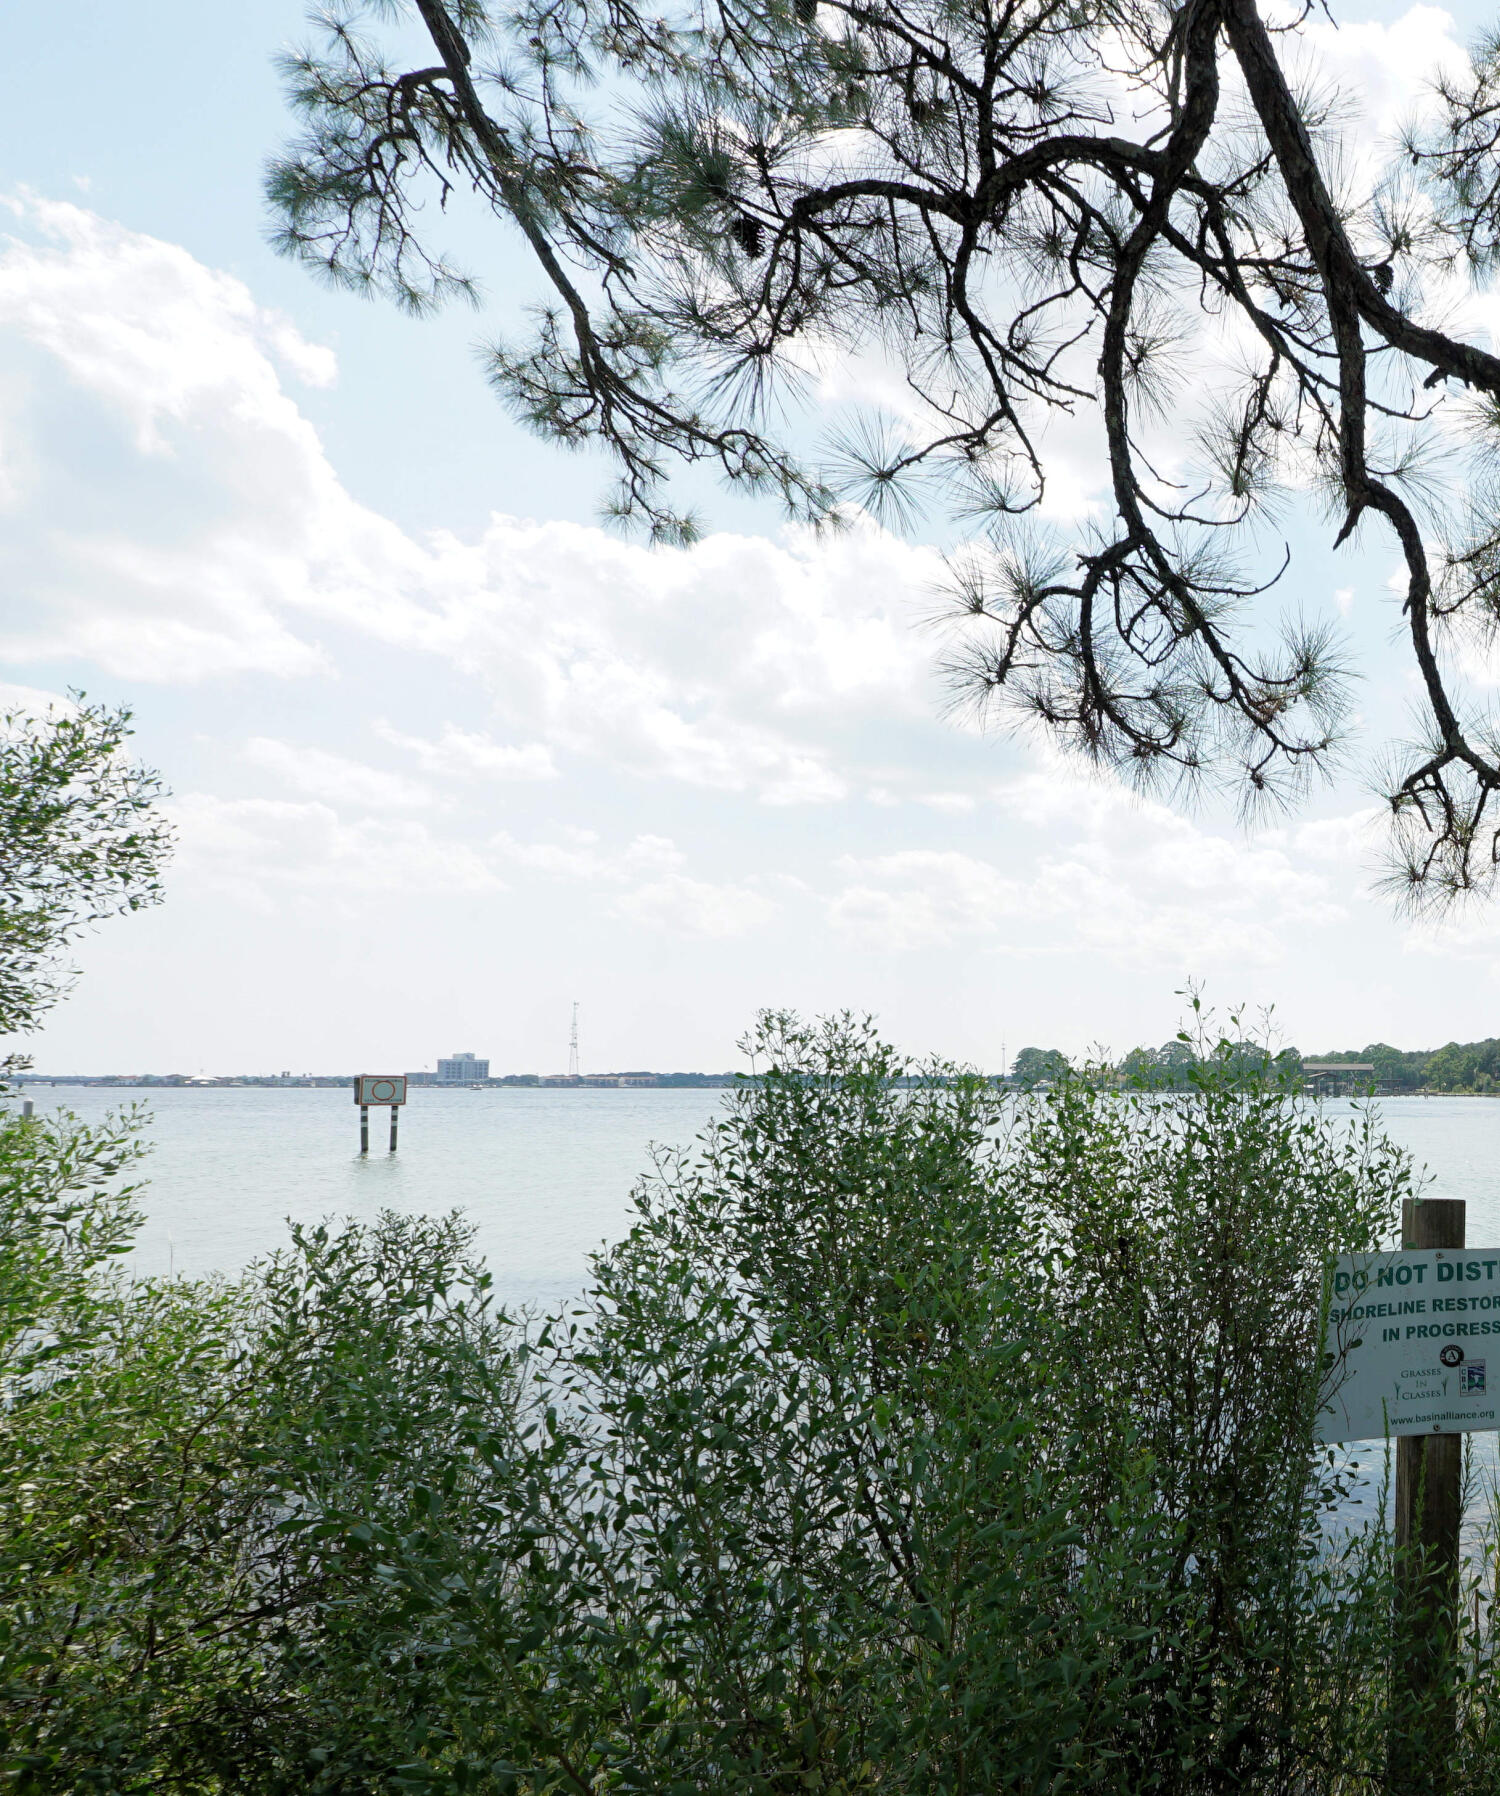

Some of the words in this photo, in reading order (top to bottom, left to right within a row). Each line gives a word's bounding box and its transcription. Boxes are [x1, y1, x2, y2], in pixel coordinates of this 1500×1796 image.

[1335, 1270, 1368, 1292] DO
[1377, 1263, 1428, 1287] NOT
[1330, 1299, 1426, 1323] SHORELINE
[1383, 1327, 1400, 1342] IN
[1391, 1410, 1495, 1426] www.basinalliance.org
